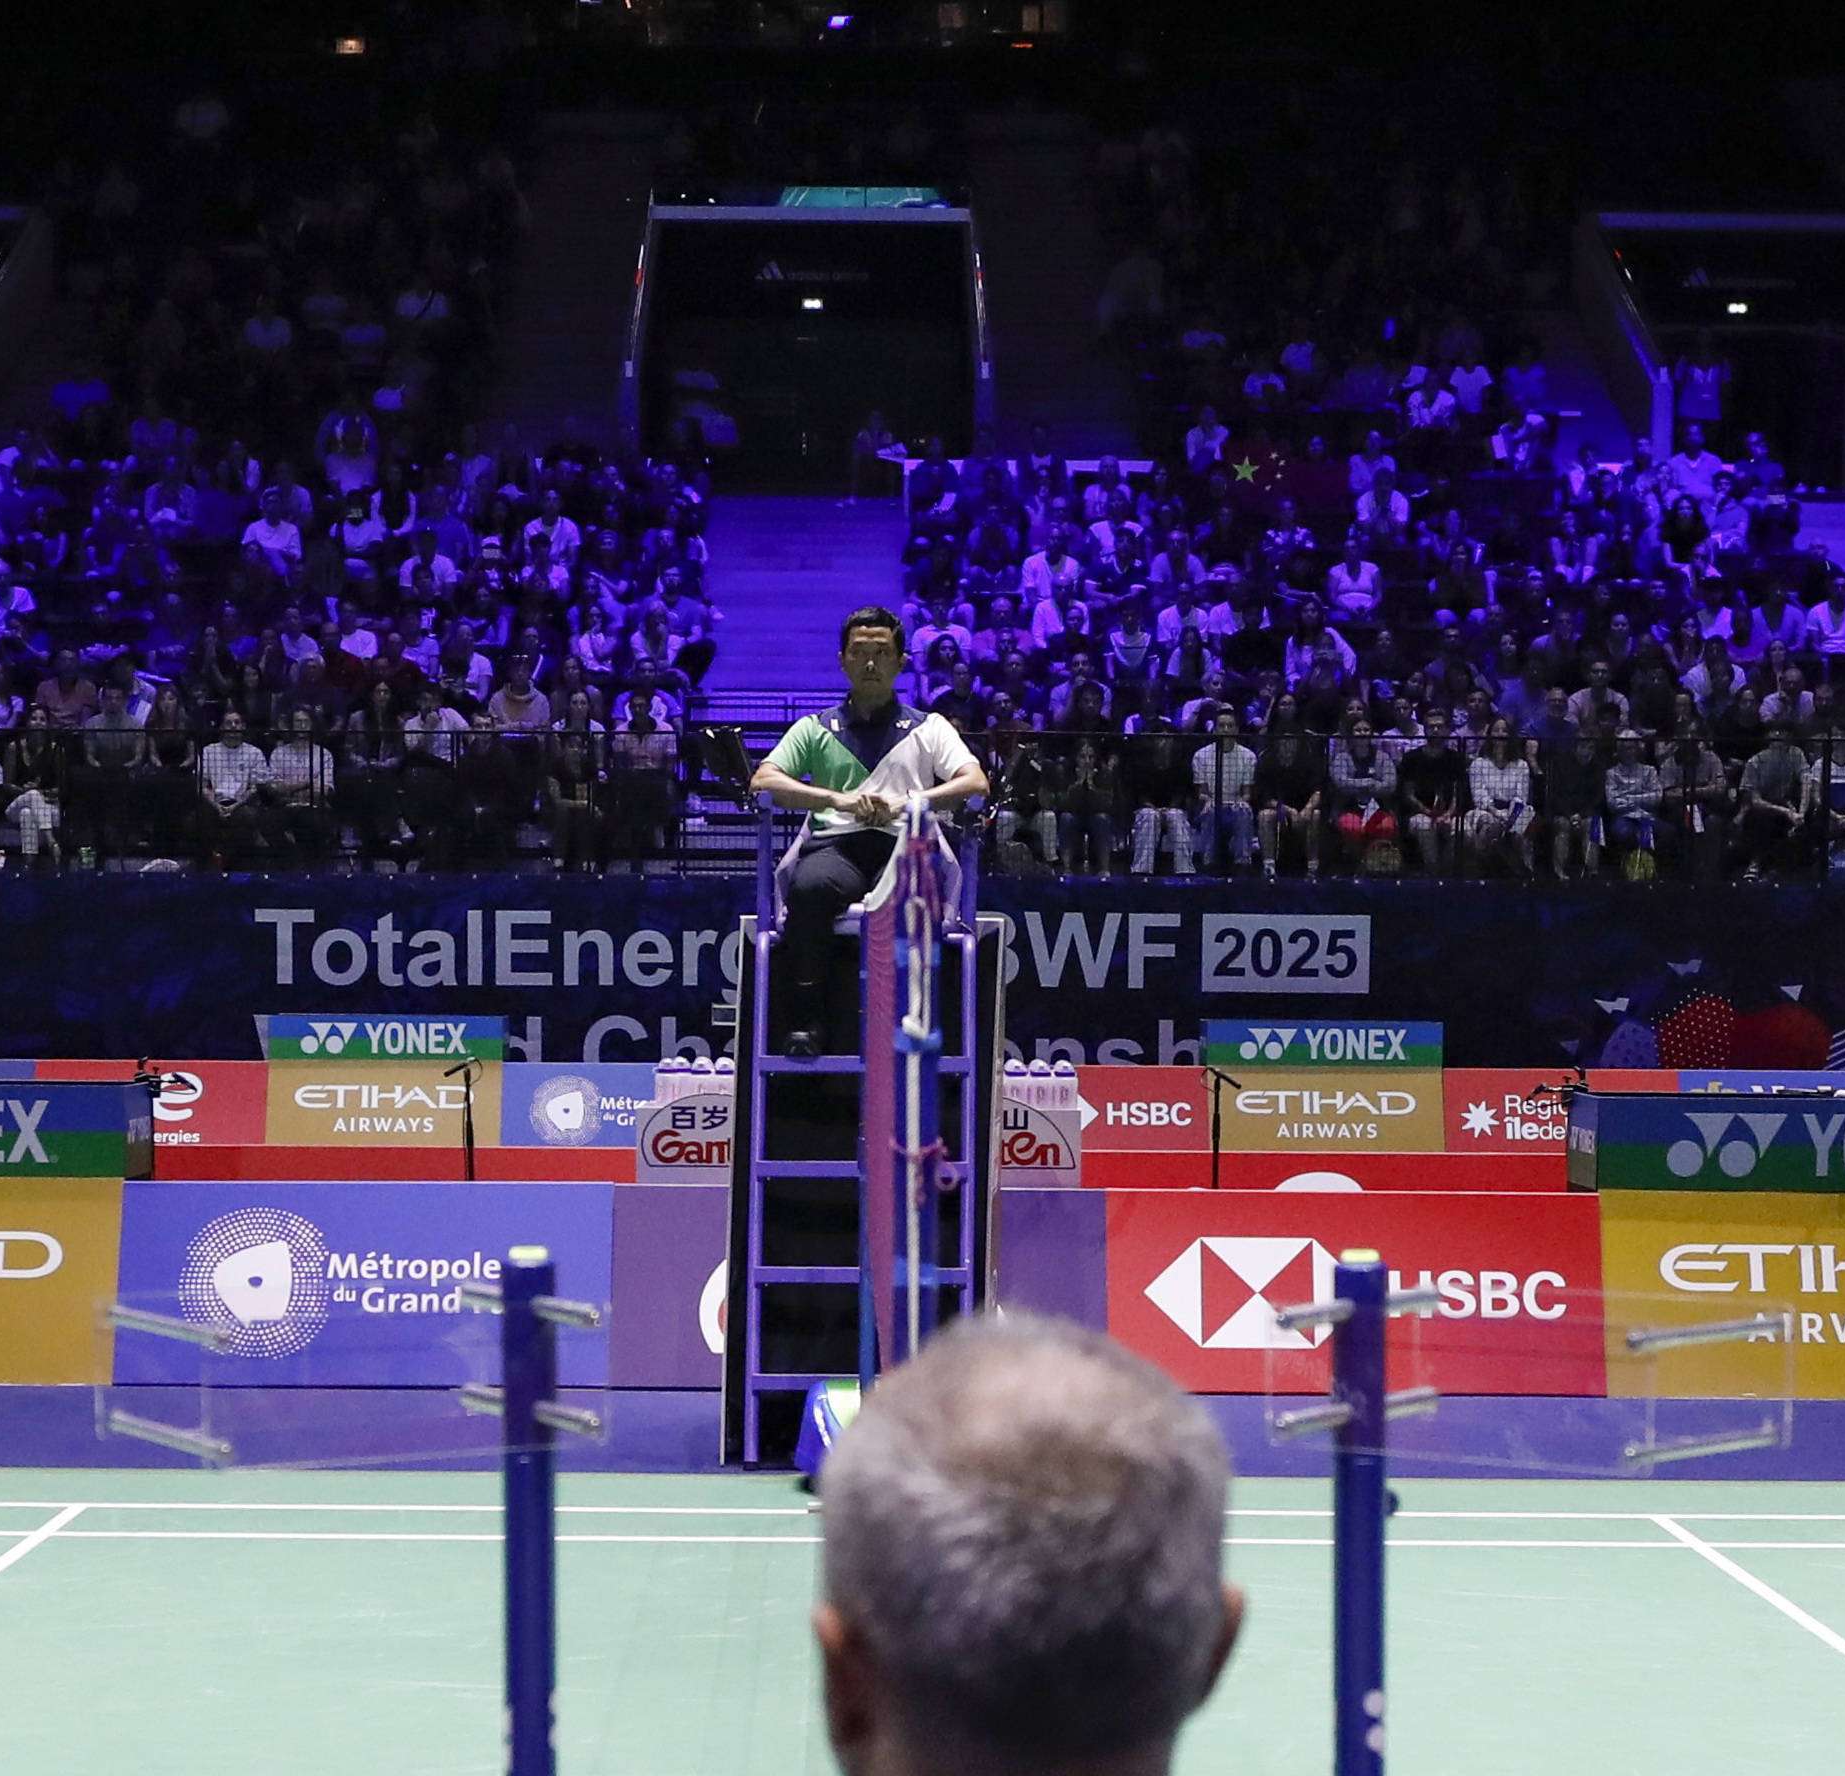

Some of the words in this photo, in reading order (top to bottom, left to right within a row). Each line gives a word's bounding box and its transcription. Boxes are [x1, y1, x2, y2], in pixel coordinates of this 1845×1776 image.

[255, 909, 756, 1005] TotalEnerg
[1212, 927, 1359, 979] 2025
[364, 1022, 467, 1056] YONEX
[1304, 1028, 1408, 1062] YONEX
[294, 1085, 474, 1110] ETIHAD
[1235, 1090, 1417, 1115] ETIHAD
[333, 1117, 434, 1133] AIRWAYS
[671, 1105, 729, 1130] 百岁
[1106, 1102, 1192, 1128] HSBC
[1277, 1123, 1377, 1139] AIRWAYS
[652, 1130, 731, 1164] Gan
[327, 1251, 501, 1286] Métropole
[333, 1285, 356, 1302] du
[361, 1286, 461, 1313] Grand
[1388, 1270, 1566, 1320] HSBC
